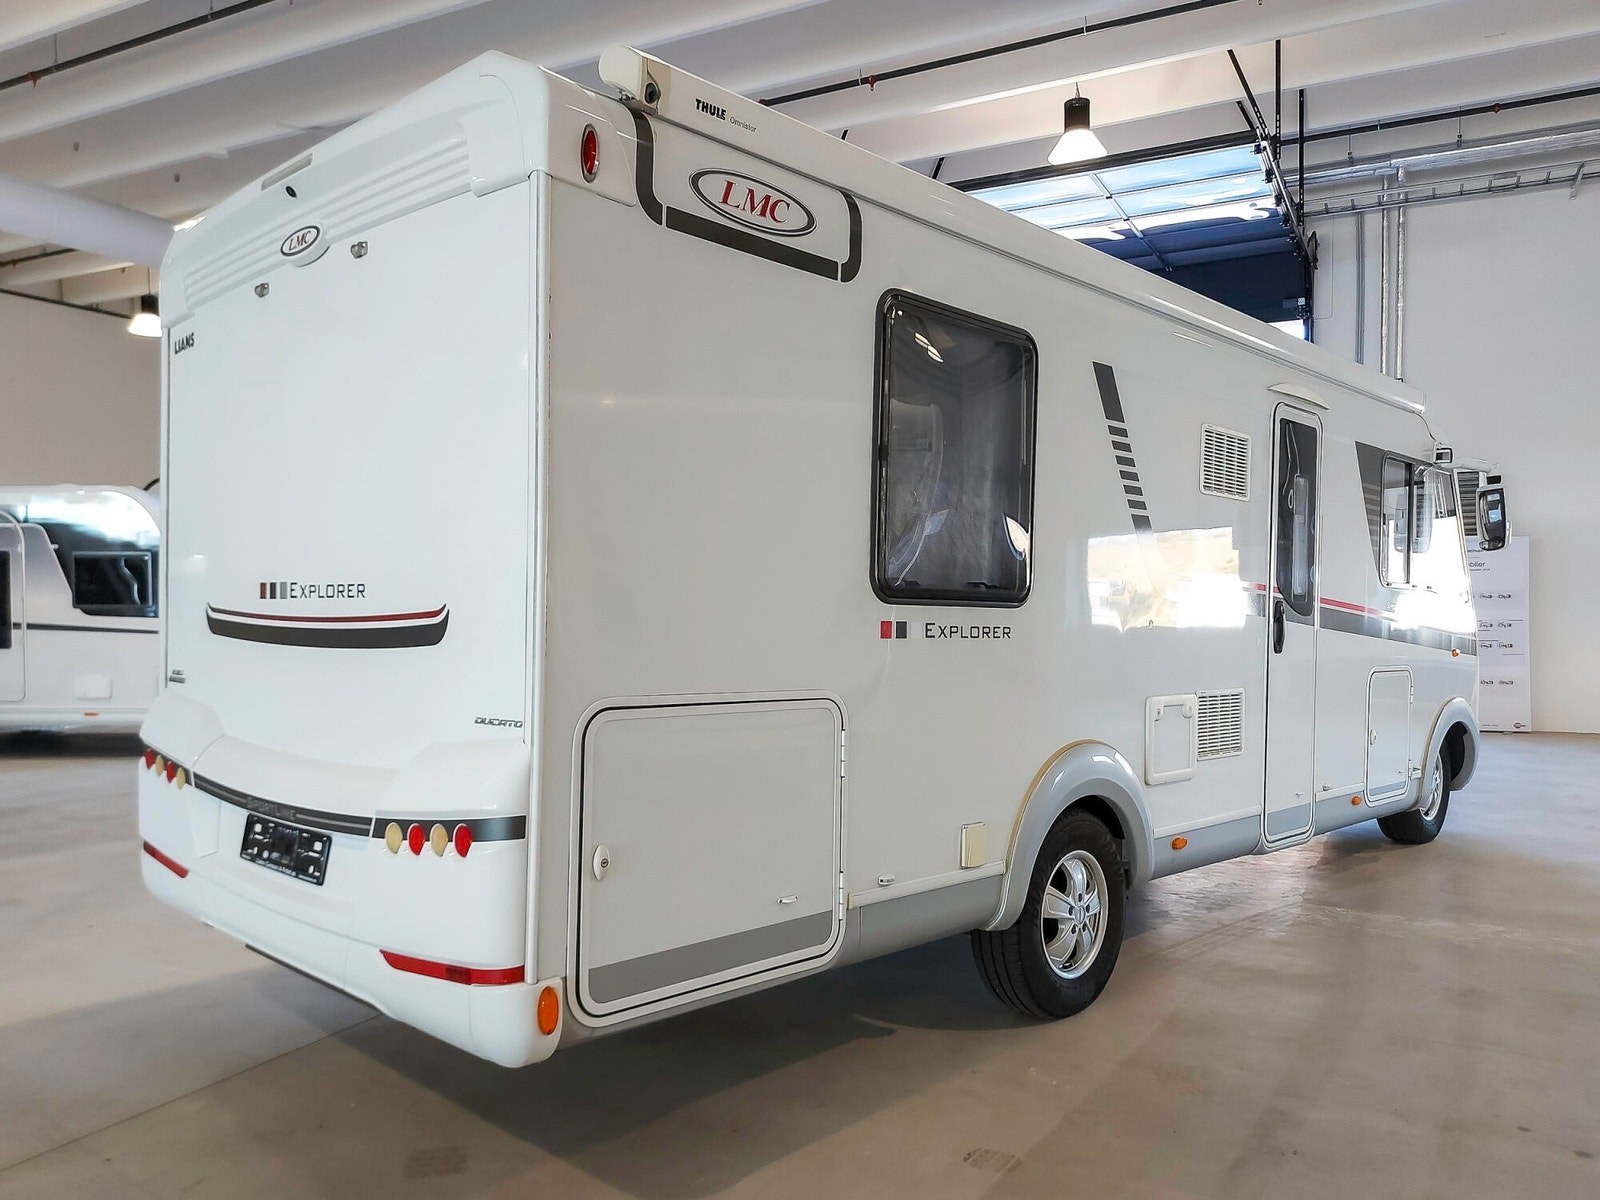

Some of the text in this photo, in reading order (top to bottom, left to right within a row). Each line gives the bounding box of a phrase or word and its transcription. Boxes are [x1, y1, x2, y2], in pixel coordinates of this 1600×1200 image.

[695, 98, 757, 133] THULE Omnistor
[718, 179, 791, 224] LMC
[288, 230, 312, 251] LMC
[174, 332, 195, 355] LIANS
[289, 581, 366, 599] EXPLORER
[925, 622, 1012, 639] EXPLORER
[474, 716, 524, 728] DUCATO
